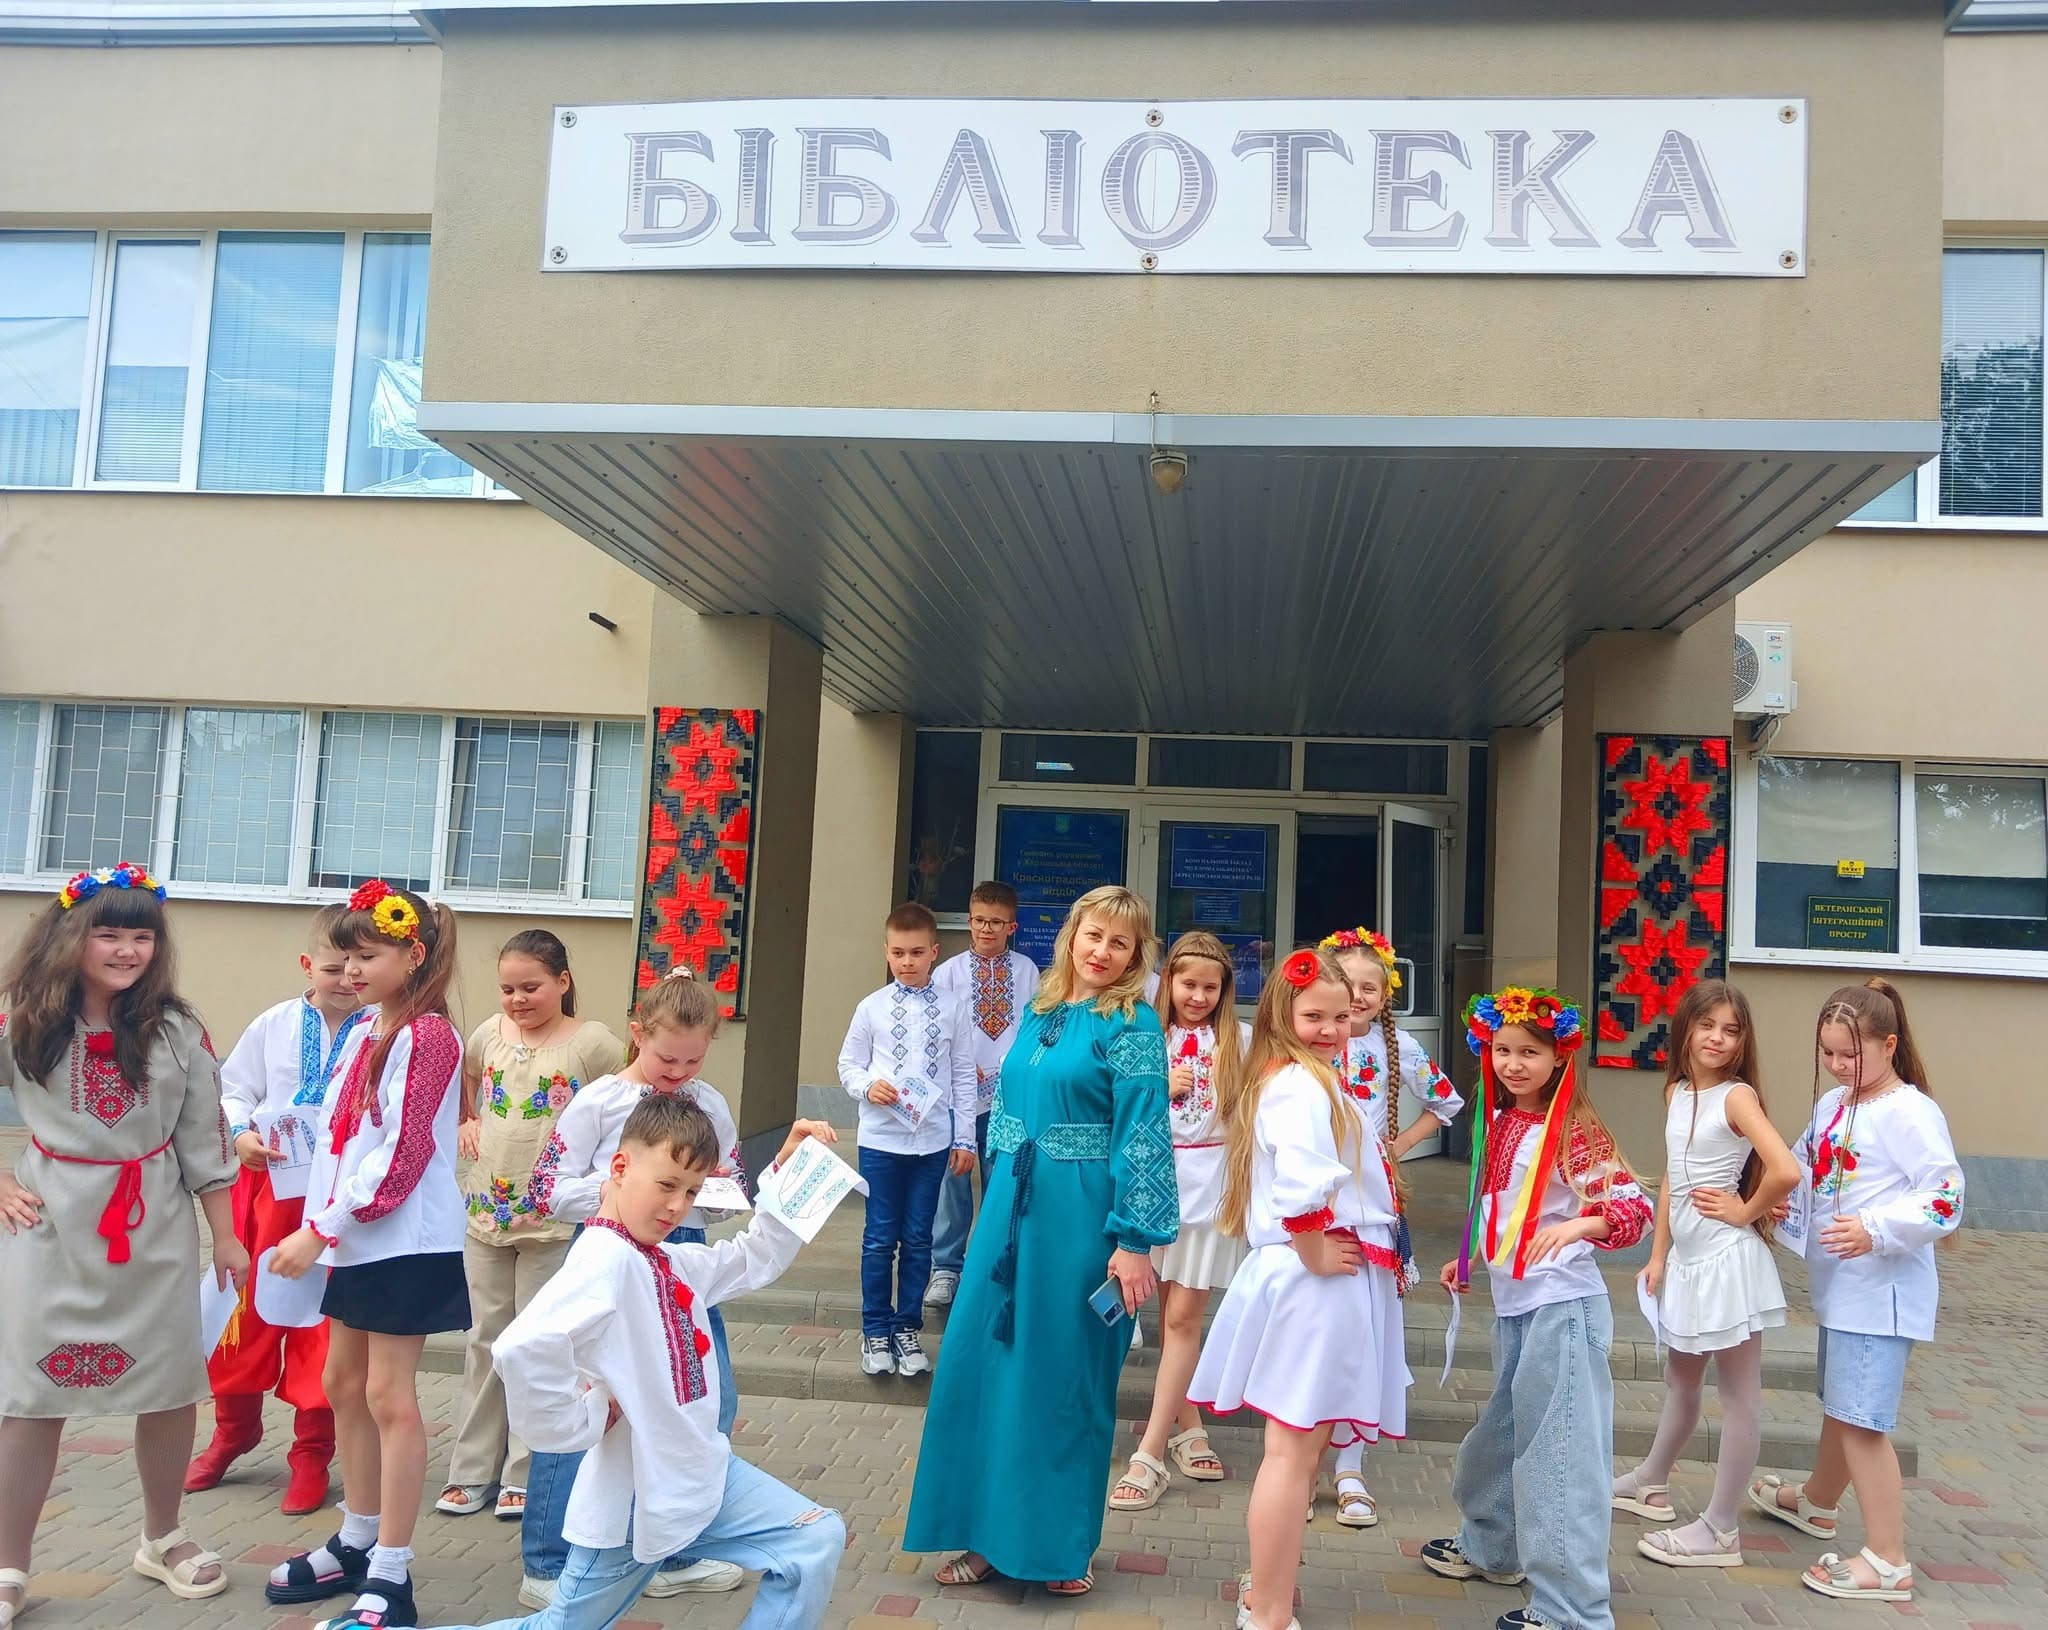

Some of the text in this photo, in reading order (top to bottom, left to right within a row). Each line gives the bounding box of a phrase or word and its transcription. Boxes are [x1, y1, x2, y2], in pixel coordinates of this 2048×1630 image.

[618, 126, 1743, 253] БІБЛІОТЕКА
[1815, 904, 1882, 914] ВЕТЕРАНСЬКИЙ
[1829, 930, 1867, 939] ПРОСТІР
